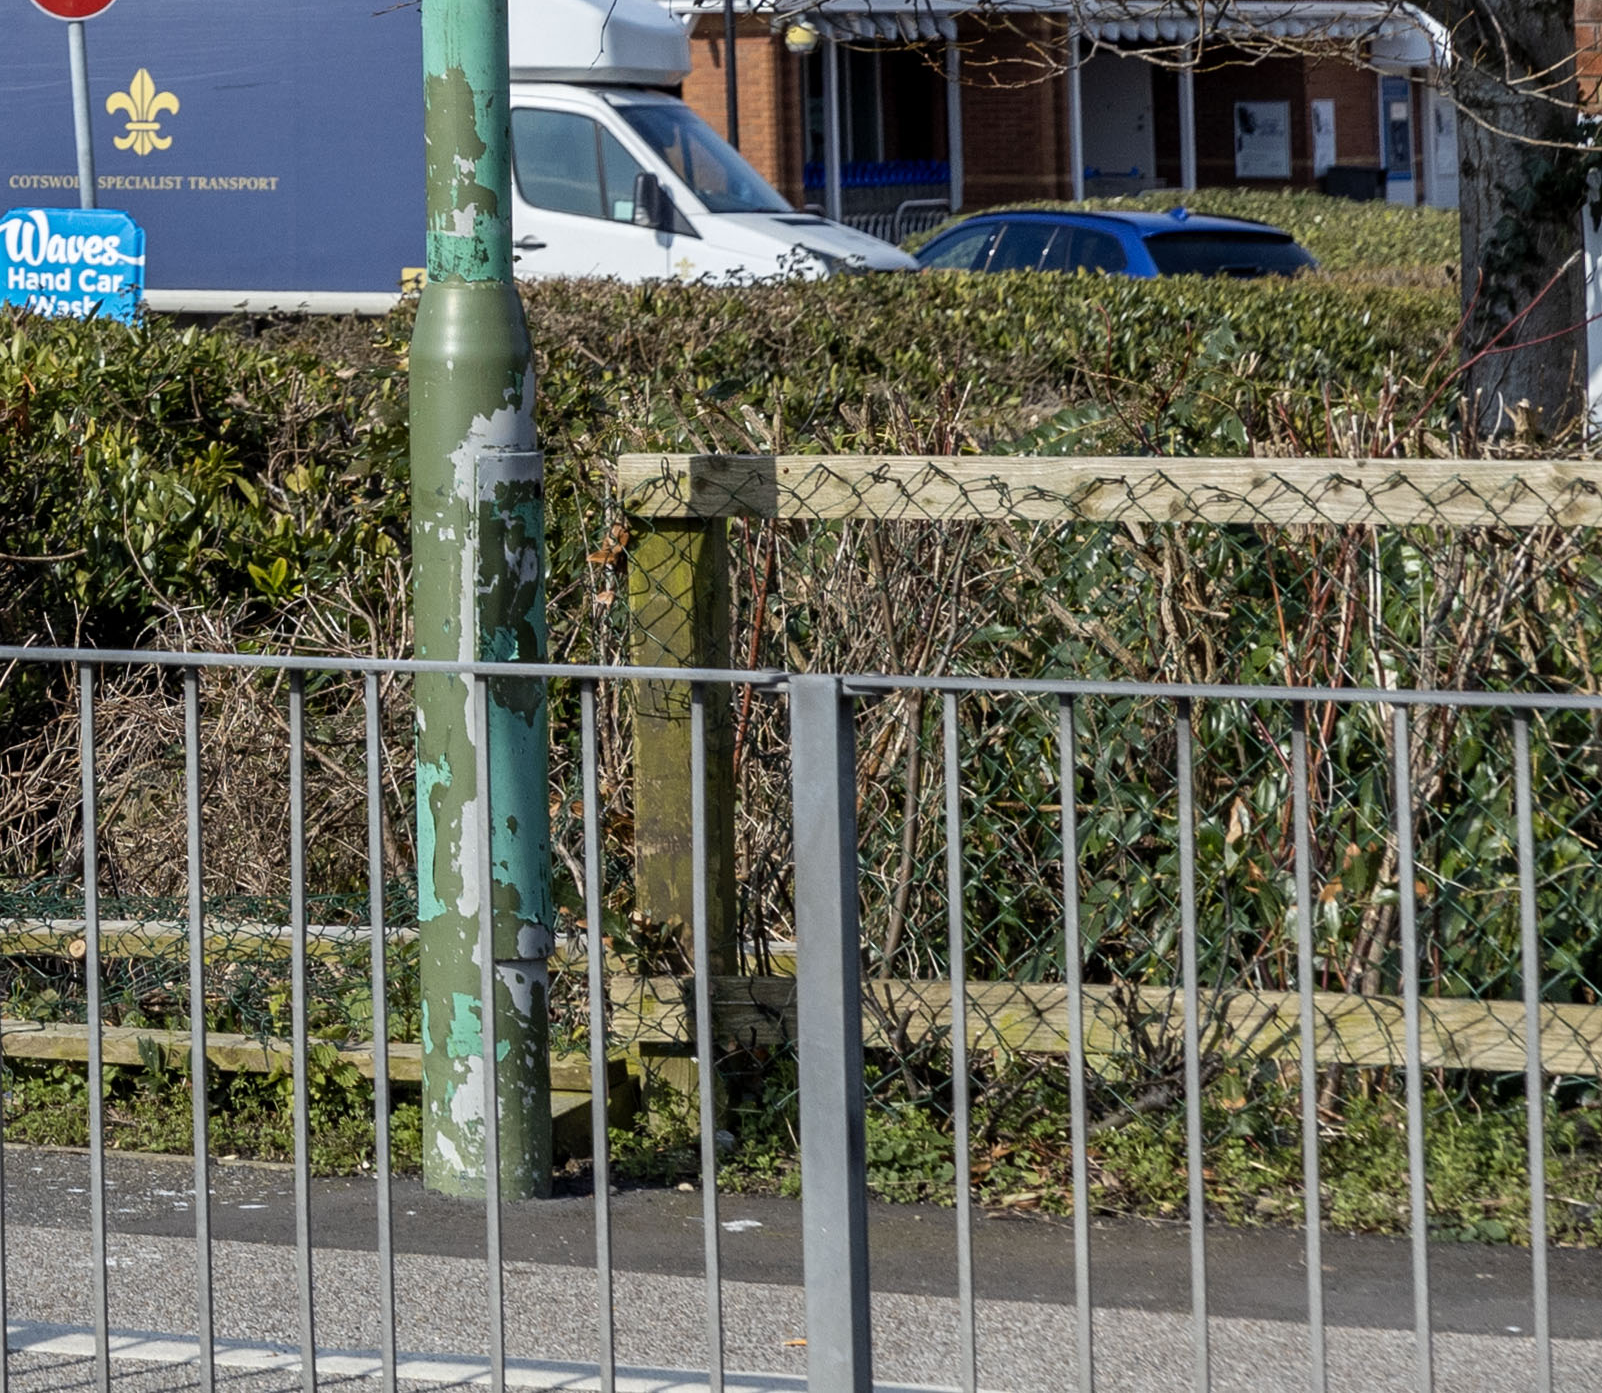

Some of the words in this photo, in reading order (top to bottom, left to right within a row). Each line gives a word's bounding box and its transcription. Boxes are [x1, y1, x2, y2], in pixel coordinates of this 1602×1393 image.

[9, 175, 81, 189] COTSWOL
[98, 175, 183, 189] SPECIALIST
[188, 176, 279, 190] TRANSPORT
[8, 266, 71, 292] Hand
[78, 269, 124, 293] Car
